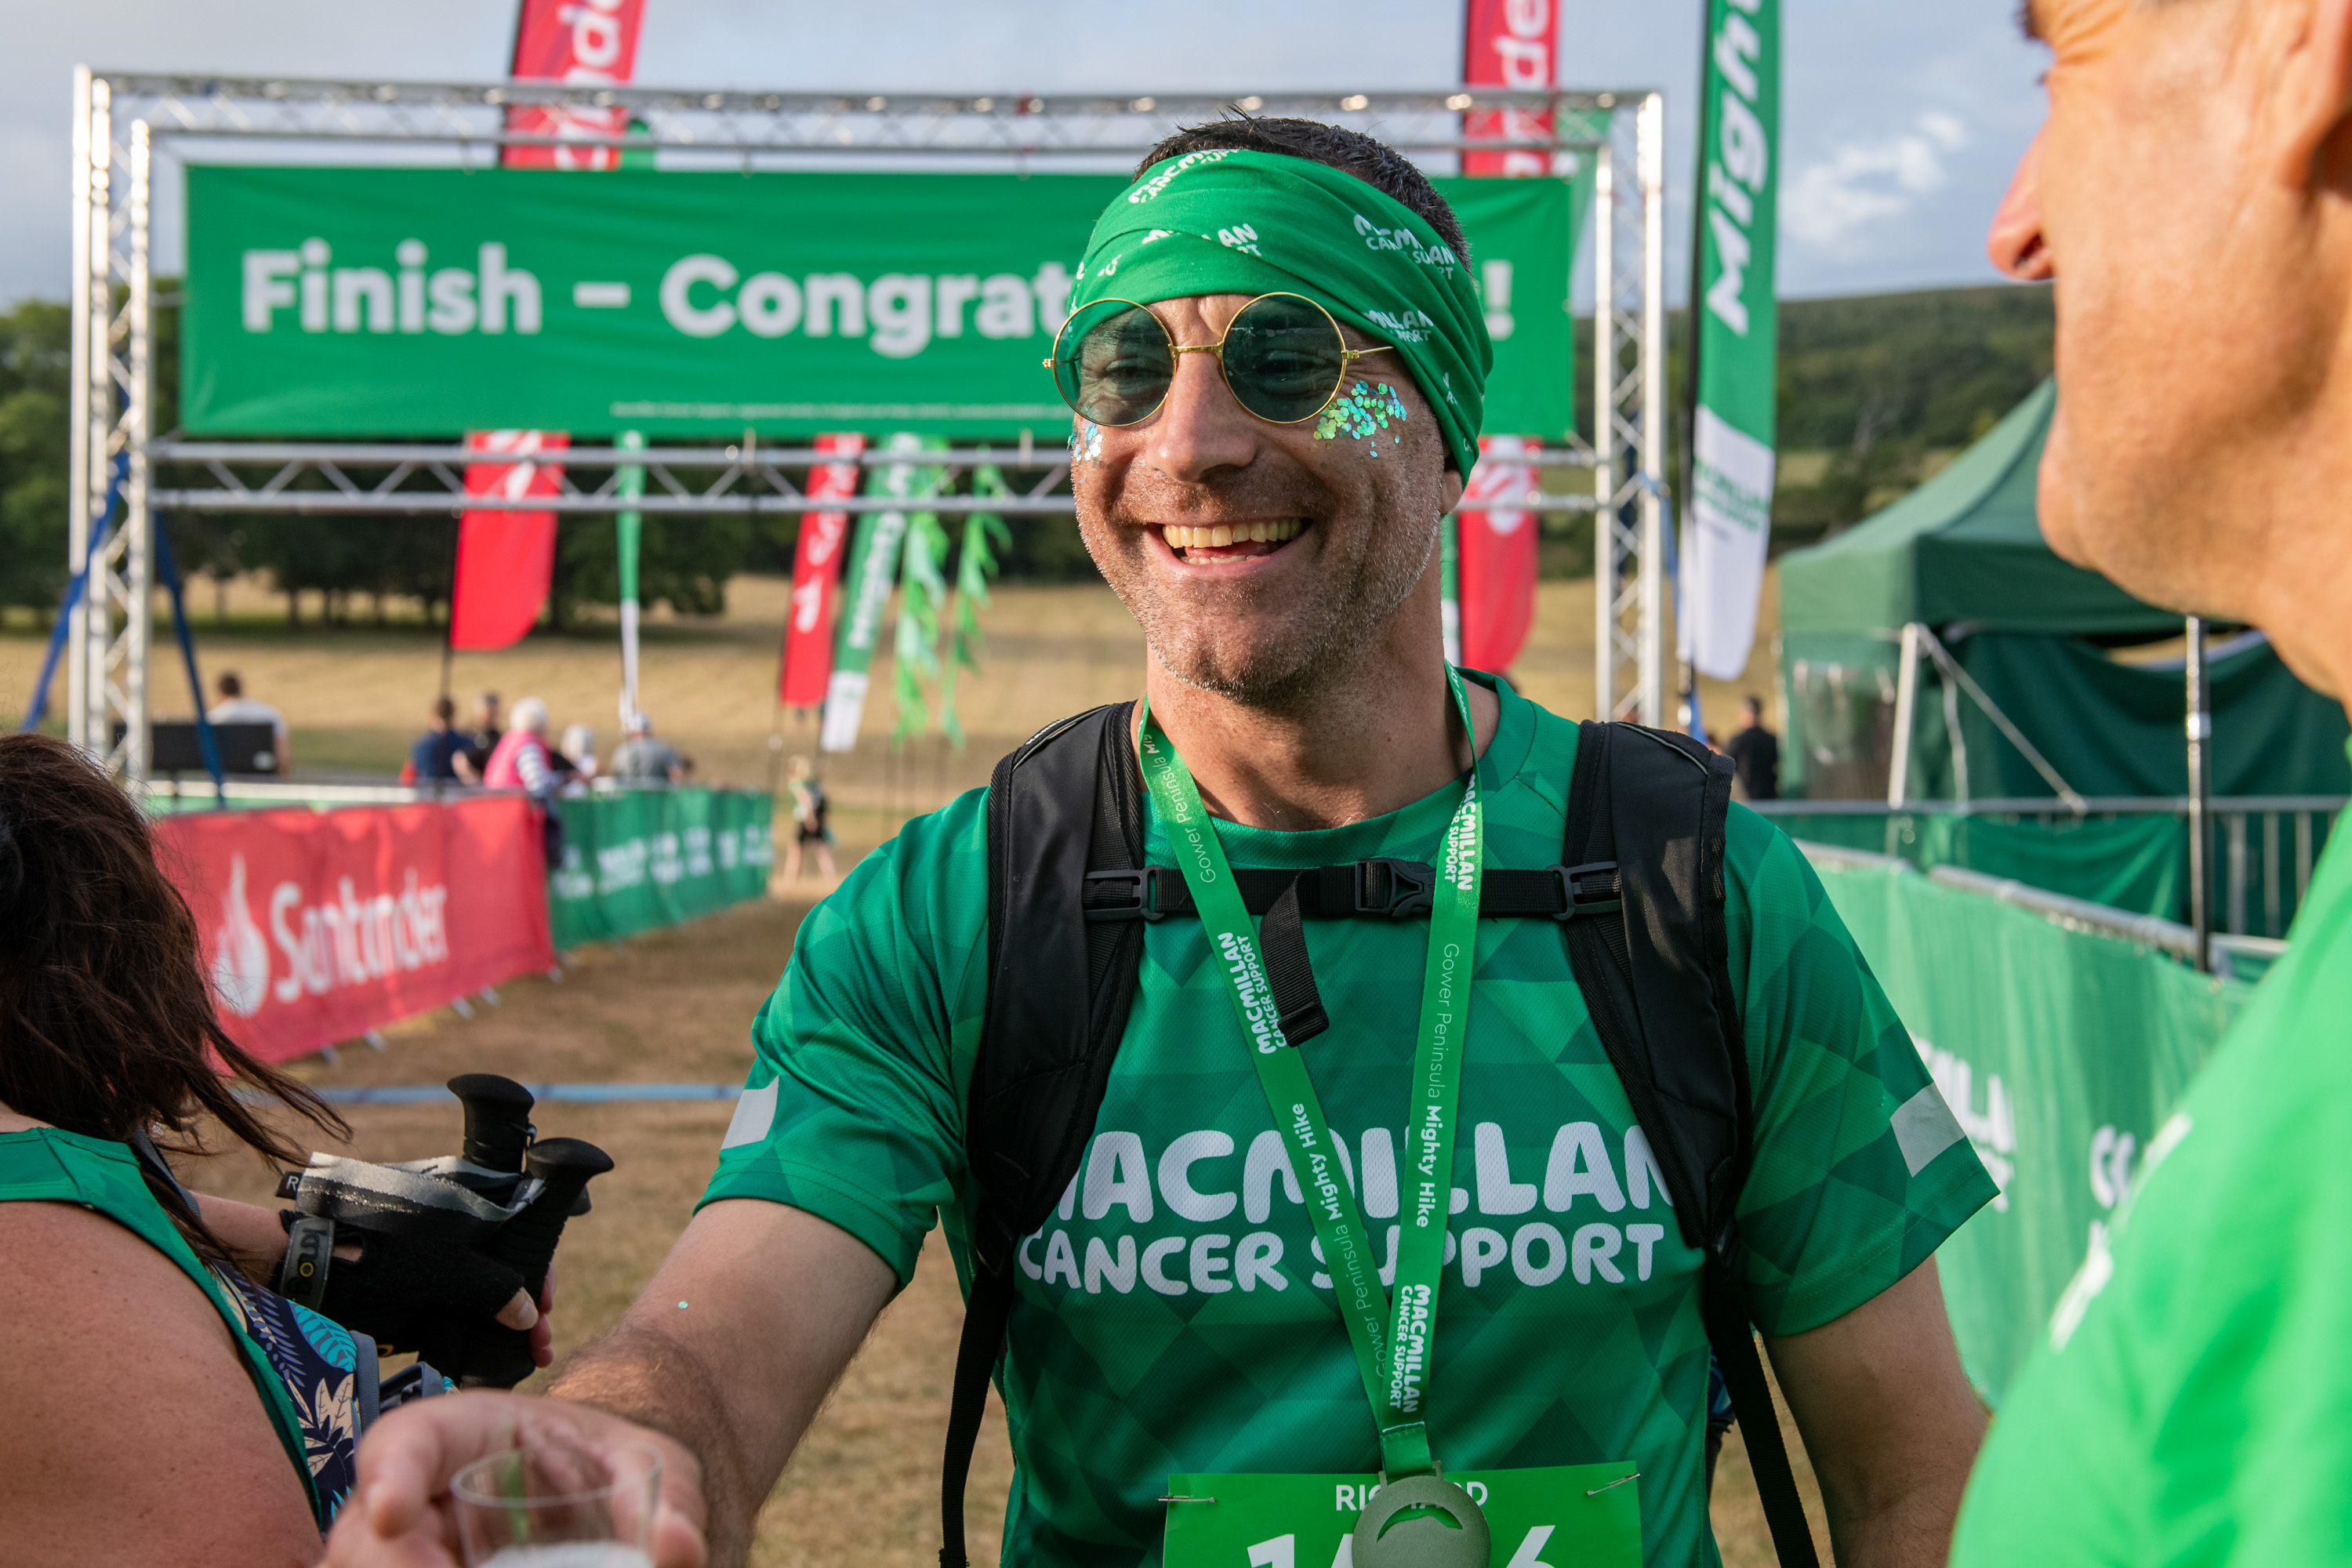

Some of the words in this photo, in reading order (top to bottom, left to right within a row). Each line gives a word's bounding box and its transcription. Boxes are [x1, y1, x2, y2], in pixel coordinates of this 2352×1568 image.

[1706, 0, 1769, 337] Migh
[241, 237, 544, 336] Finish
[659, 253, 1076, 359] Congrat
[1153, 756, 1192, 824] Peninsula
[1185, 827, 1217, 883] Gower
[1444, 825, 1460, 884] SUPPORT
[1218, 932, 1277, 1054] MACMILLAN
[1236, 935, 1268, 993] SUPPORT
[1439, 943, 1460, 1007] Gower
[1260, 994, 1287, 1047] CANCER
[1428, 1013, 1453, 1098] Peninsula
[1292, 1103, 1317, 1148] Hike
[1417, 1105, 1443, 1176] Mighty
[1308, 1152, 1343, 1221] Mighty
[1416, 1182, 1436, 1228] Hike
[1019, 1229, 1289, 1295] CANCER
[1334, 1225, 1371, 1312] Peninsula
[1396, 1286, 1412, 1341] CANCER
[1389, 1345, 1406, 1409] SUPPORT
[1403, 1283, 1432, 1413] MACMILLAN
